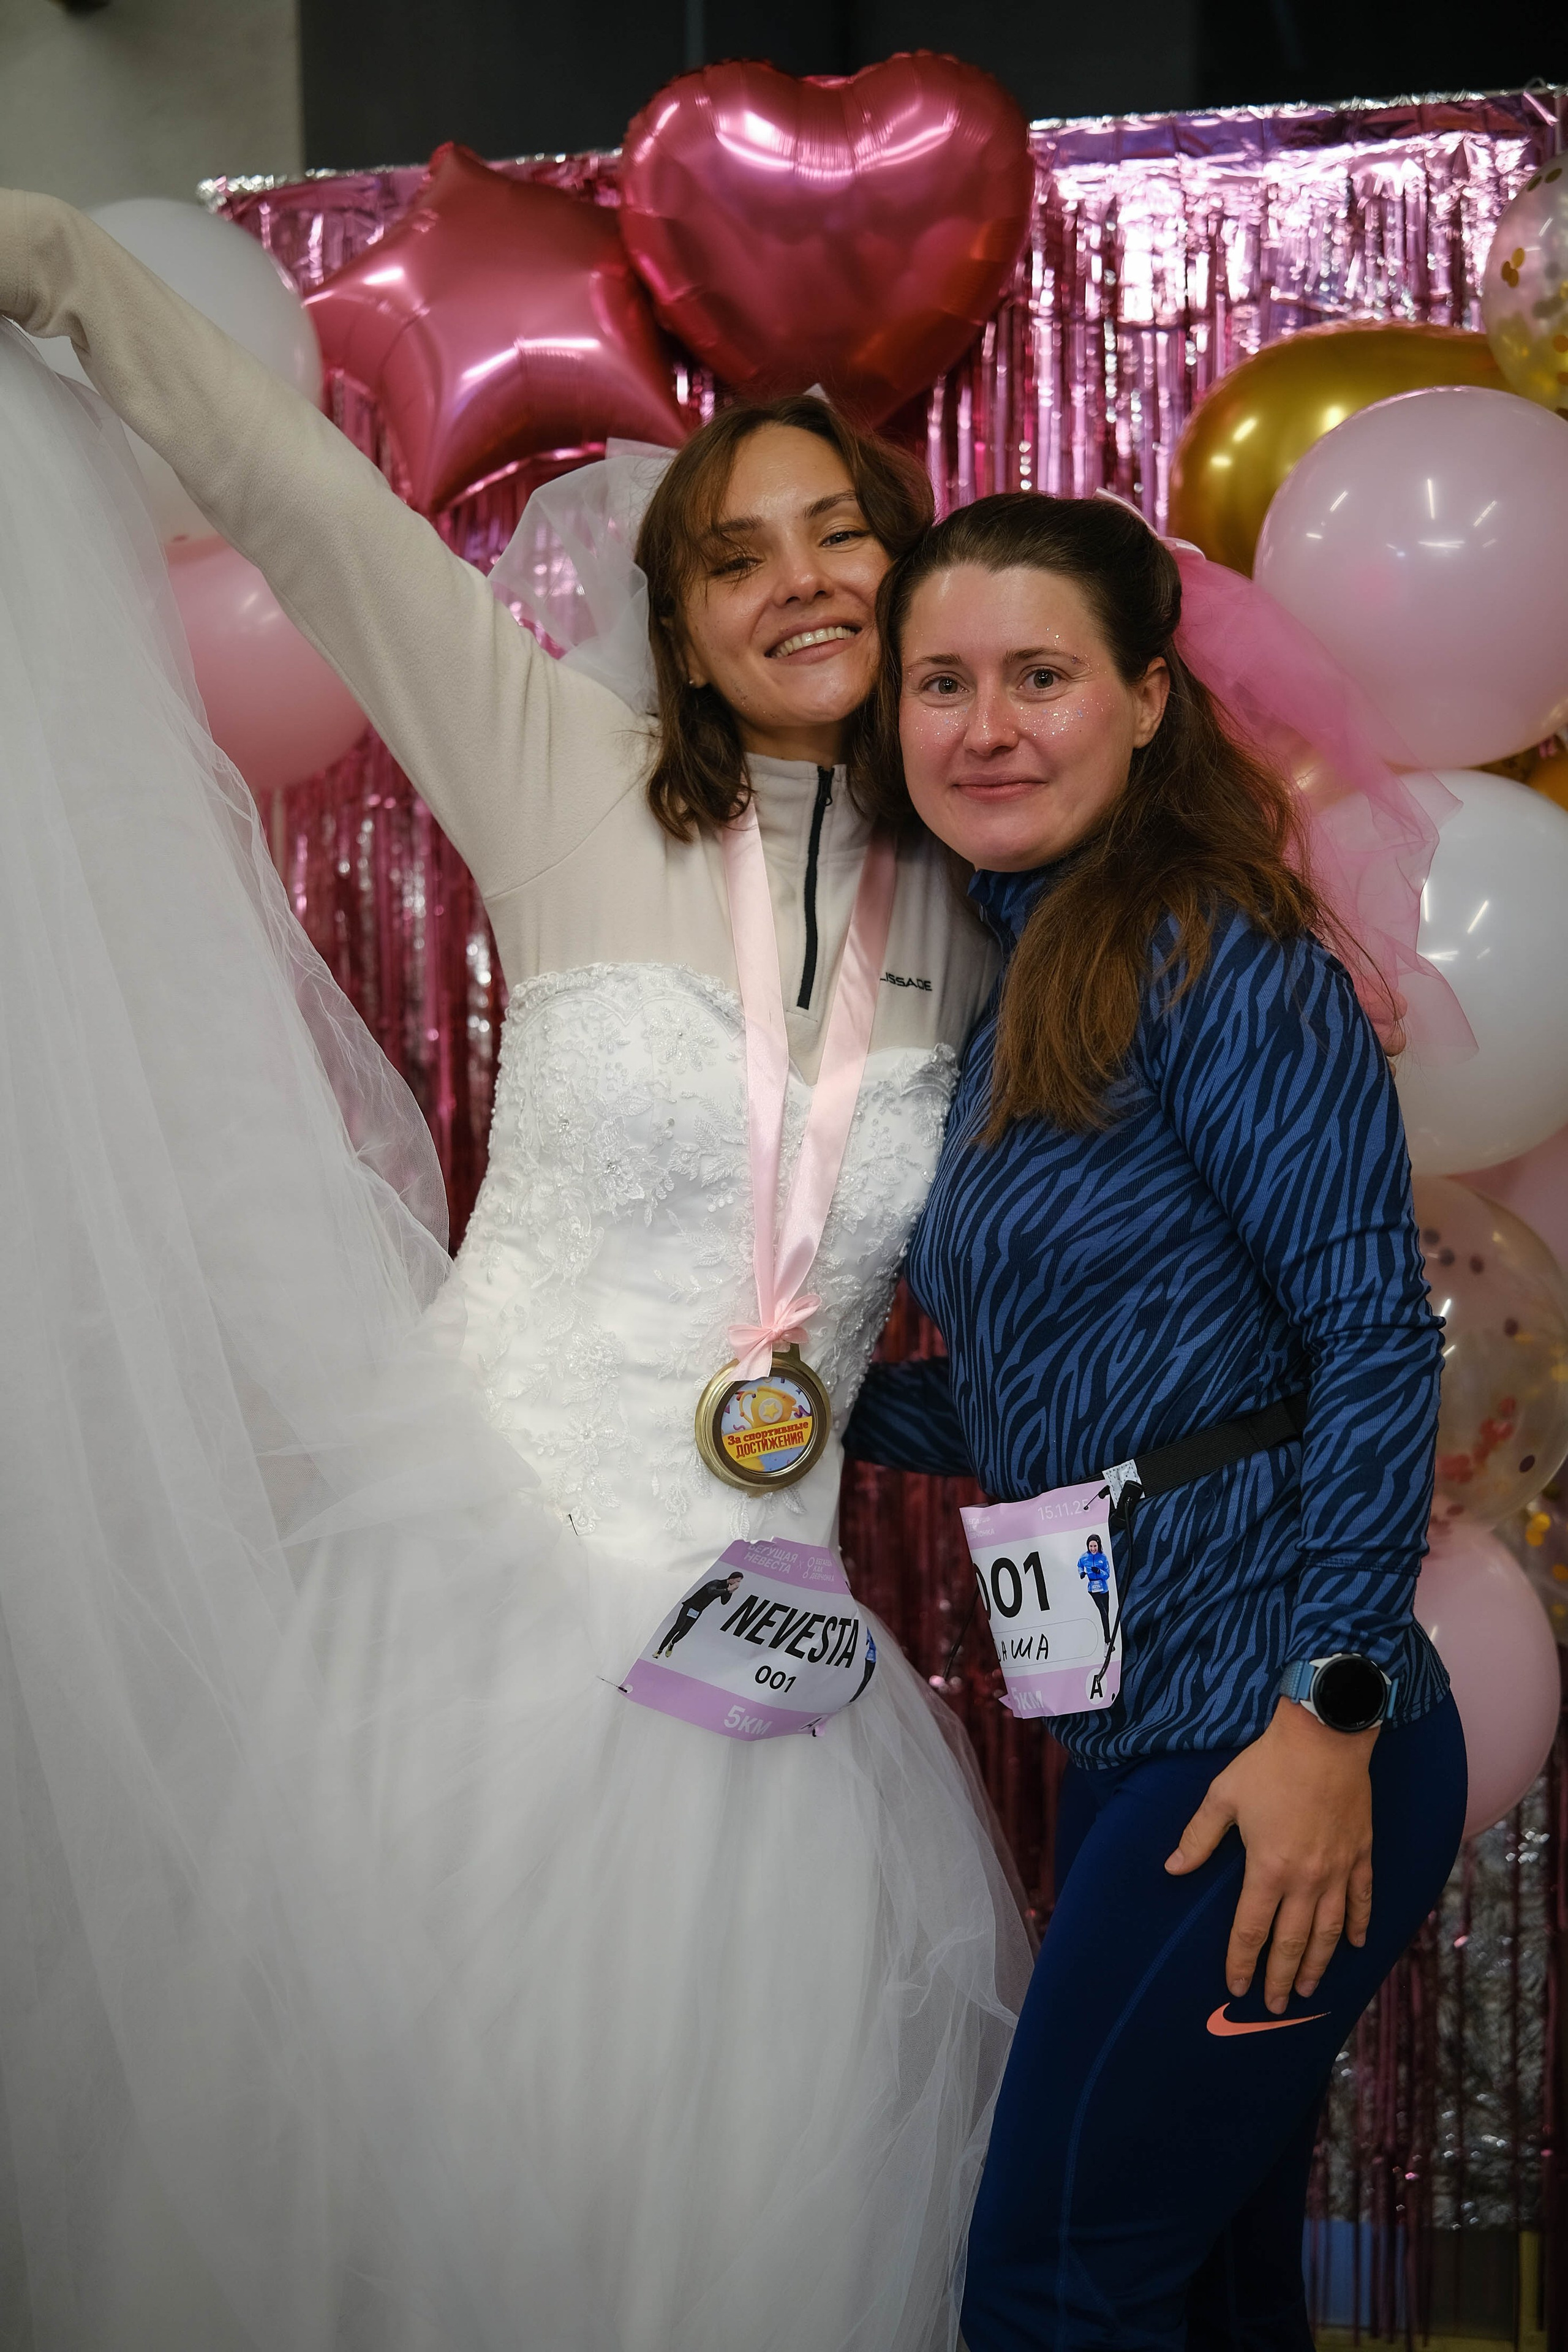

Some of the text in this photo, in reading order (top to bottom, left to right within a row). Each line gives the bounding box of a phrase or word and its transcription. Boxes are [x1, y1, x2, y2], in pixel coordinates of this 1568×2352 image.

[880, 972, 932, 991] ISSADE
[728, 1420, 809, 1446] За спортивные
[736, 1431, 805, 1459] ДОСТИЖЕНИЯ
[744, 1552, 791, 1574] НЕВЕСТА
[747, 1544, 799, 1563] БЕГУЩАЯ
[720, 1594, 859, 1668] NEVESTA
[754, 1665, 797, 1694] 001
